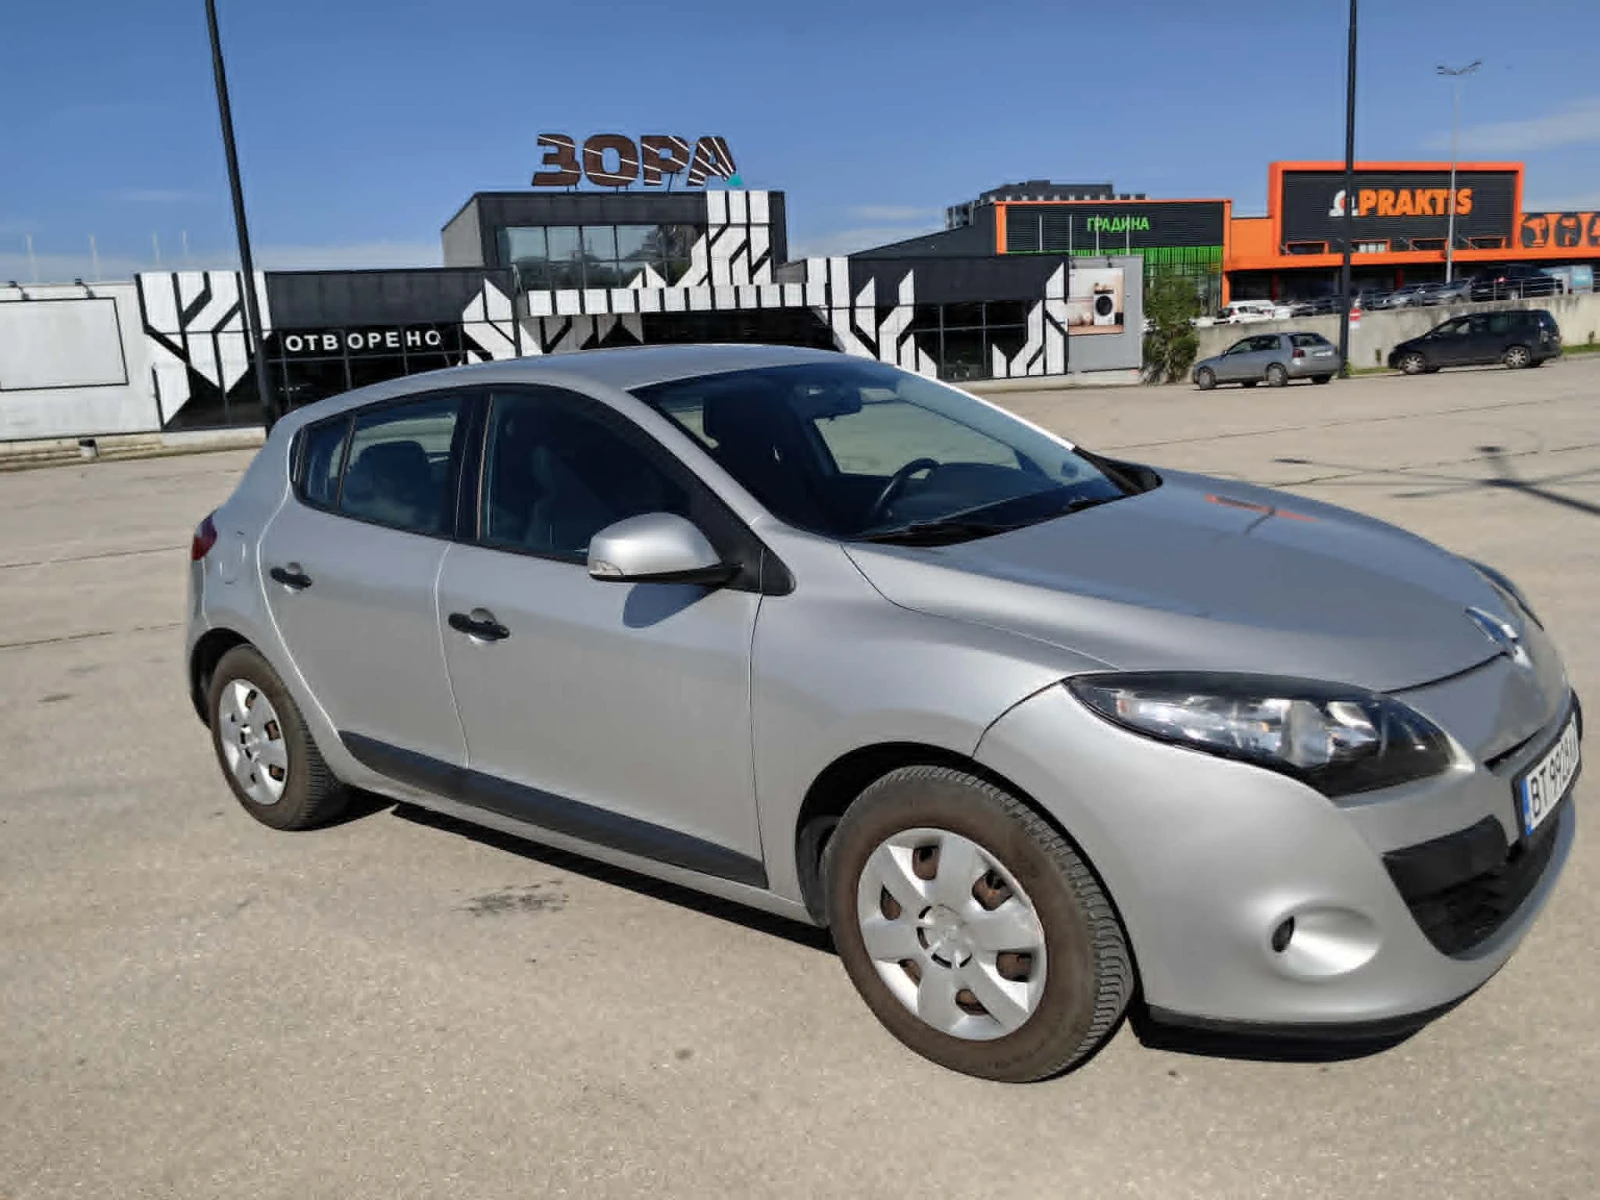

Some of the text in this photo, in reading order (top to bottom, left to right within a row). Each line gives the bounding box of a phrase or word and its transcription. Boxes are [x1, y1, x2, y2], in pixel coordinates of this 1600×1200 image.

[531, 133, 743, 187] ЗОРА
[1358, 188, 1473, 216] PRAKTIS
[1087, 216, 1150, 234] ГРАДИНА
